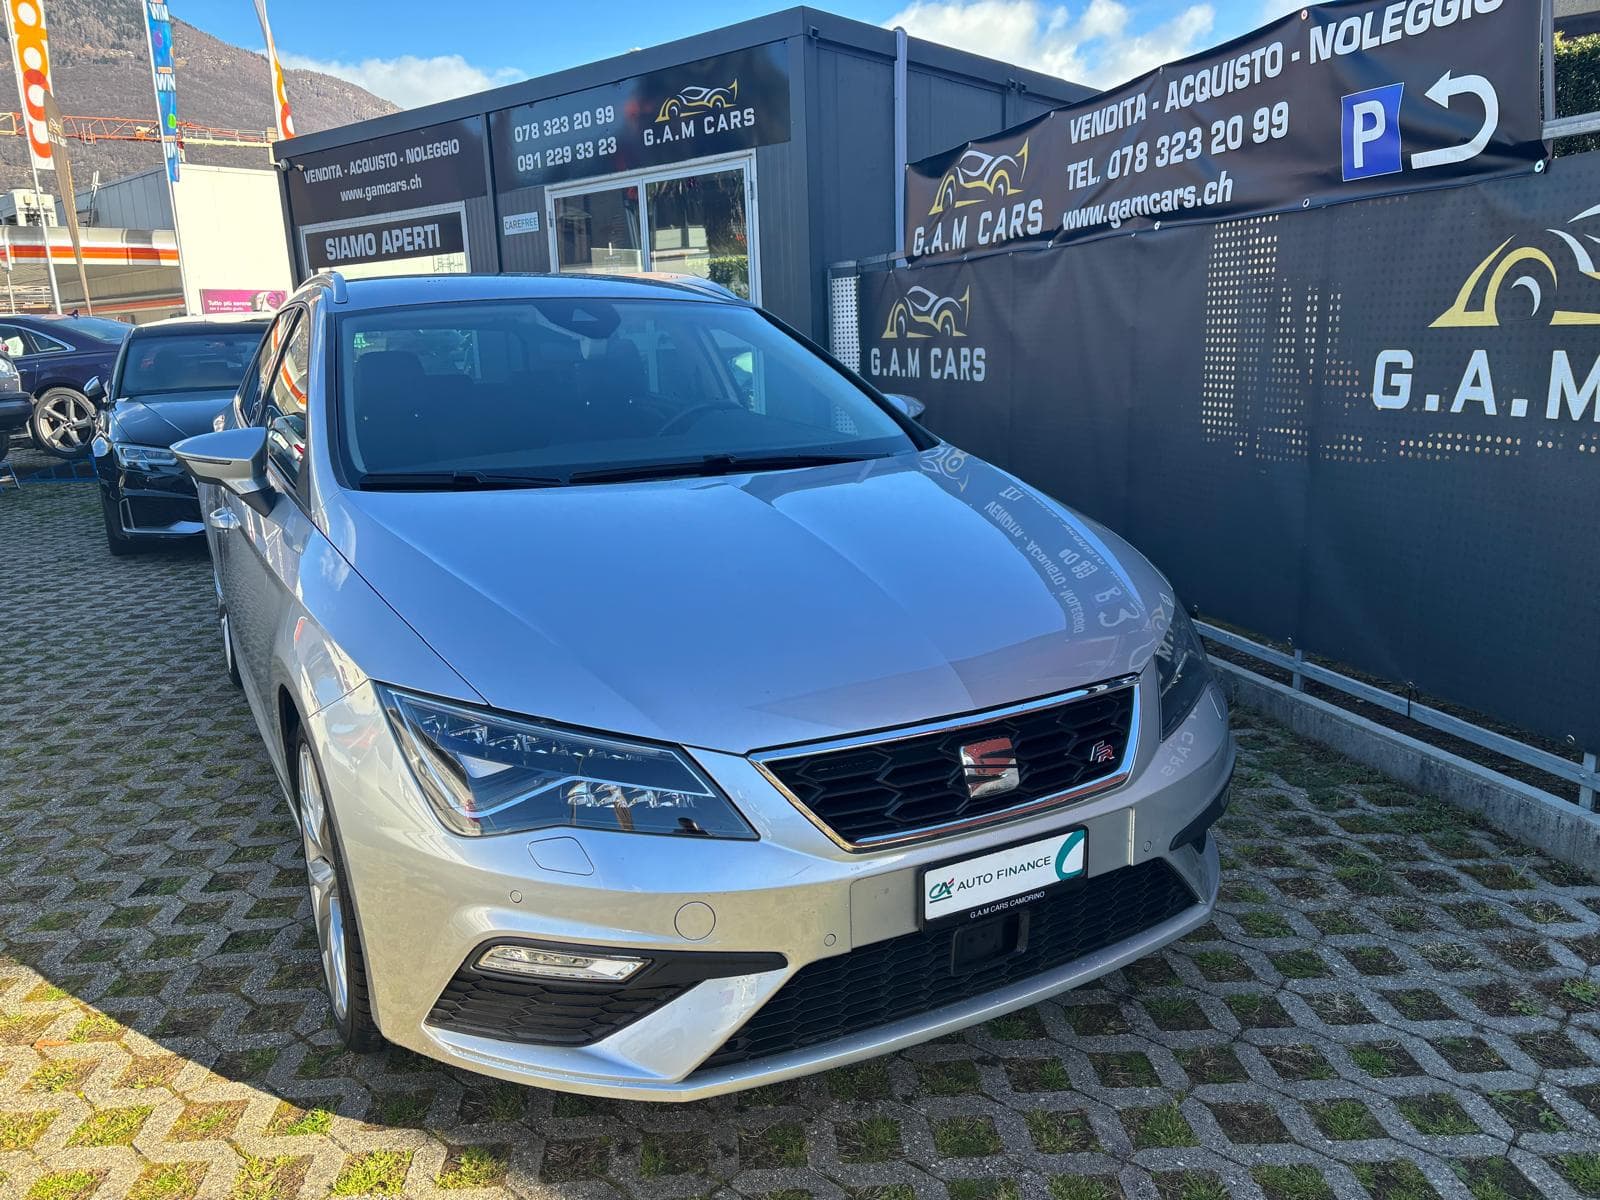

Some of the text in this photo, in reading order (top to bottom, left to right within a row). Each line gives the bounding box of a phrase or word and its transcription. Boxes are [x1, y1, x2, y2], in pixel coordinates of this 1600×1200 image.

[156, 73, 176, 91] WIN
[1070, 93, 1147, 144] VENDITA
[1164, 42, 1284, 113] ACQUISTO
[514, 105, 615, 143] 078 323 20 99
[643, 107, 755, 146] G.A.M CARS
[1353, 100, 1387, 169] P
[304, 164, 343, 184] VENDITA
[350, 152, 398, 175] ACQUISTO
[406, 139, 460, 165] NOLEGGIO
[517, 137, 617, 173] 091 229 33 23
[1067, 101, 1289, 191] TEL. 078 323 20 99
[340, 174, 422, 201] www.gamcars.ch
[1063, 170, 1233, 231] www.gamcars.ch
[325, 223, 441, 261] SIAMO APERTI
[504, 217, 538, 230] CAREFREE
[912, 198, 1043, 257] G.A.M CARS
[870, 347, 986, 382] G.A.M CARS
[1372, 350, 1600, 423] G.A.M
[957, 872, 993, 892] AUTO
[996, 856, 1051, 880] FINANCE
[970, 890, 1045, 919] G.A.M CARS CAMORINO
